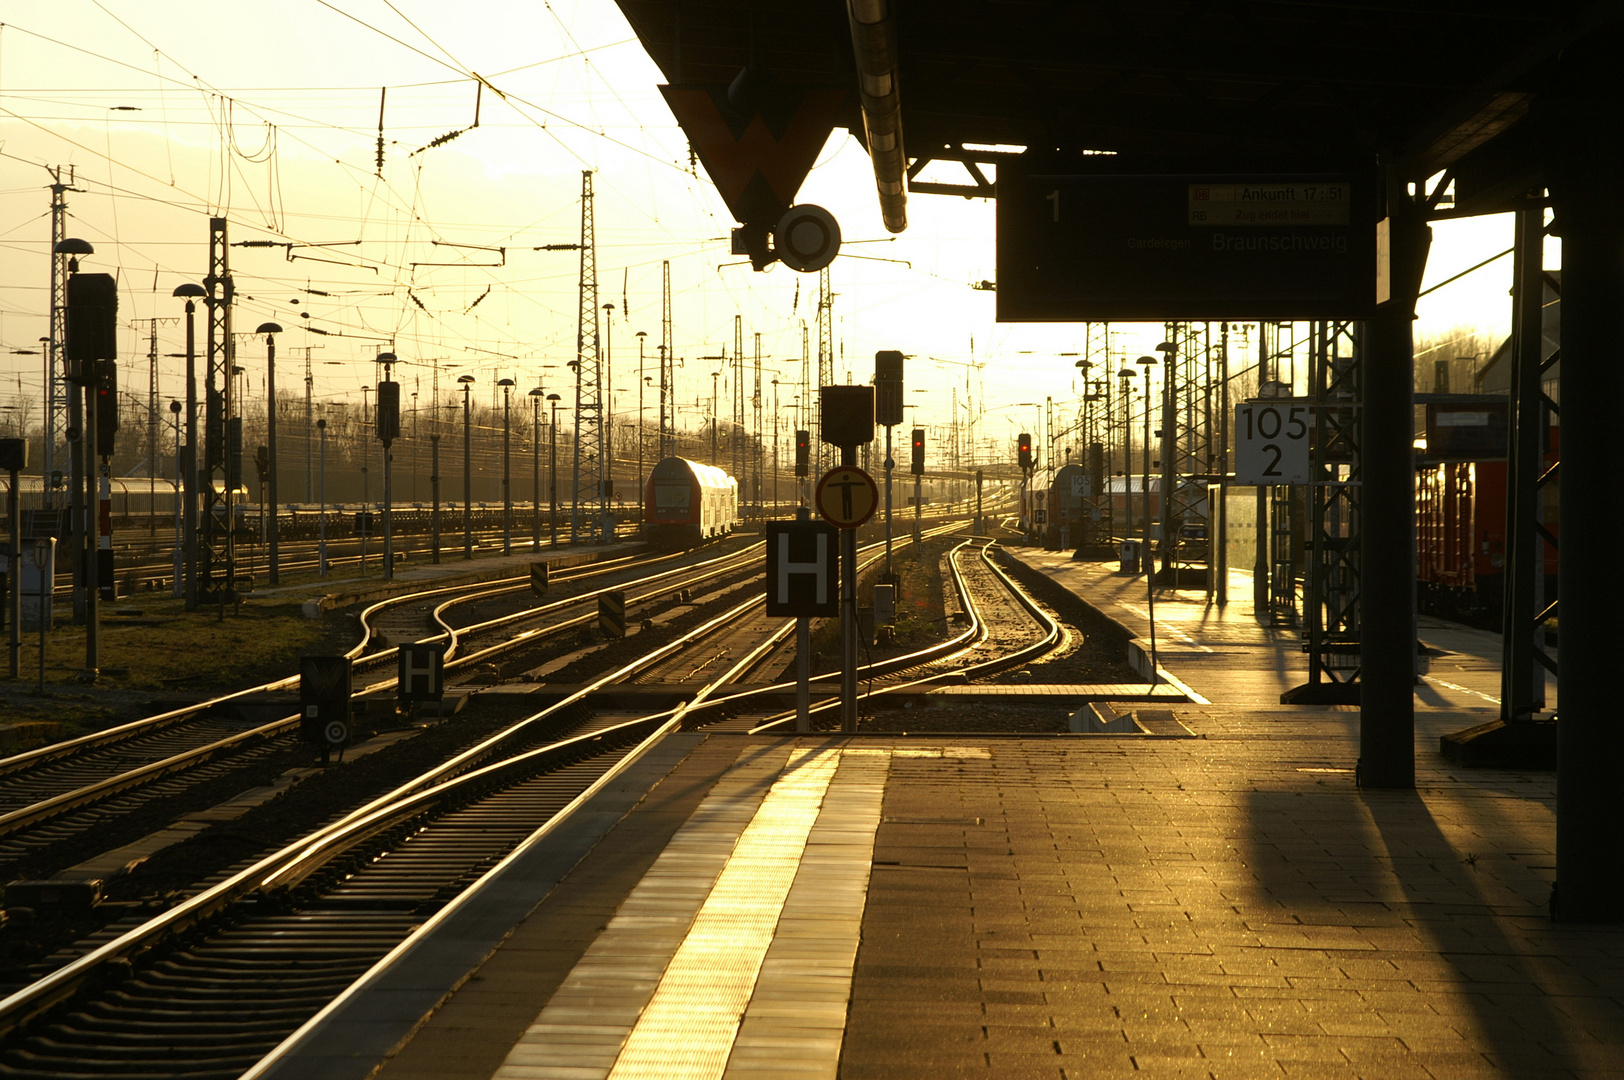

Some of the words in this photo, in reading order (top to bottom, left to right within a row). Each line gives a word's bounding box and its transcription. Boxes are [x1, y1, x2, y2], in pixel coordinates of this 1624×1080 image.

[666, 89, 848, 206] W
[1241, 187, 1295, 200] Ankunft
[1045, 189, 1060, 223] 1
[1192, 211, 1207, 221] RB
[1236, 210, 1256, 222] Zug
[1259, 210, 1288, 220] endet
[1291, 210, 1310, 220] hier
[1127, 237, 1191, 250] Gardelegen
[1212, 232, 1347, 254] Braunschweig
[1242, 407, 1307, 440] 105
[1261, 444, 1282, 476] 2
[1072, 476, 1090, 486] 105
[1078, 486, 1084, 495] 4
[1036, 511, 1044, 520] H
[777, 533, 828, 604] H
[302, 659, 346, 695] W
[405, 650, 437, 694] H
